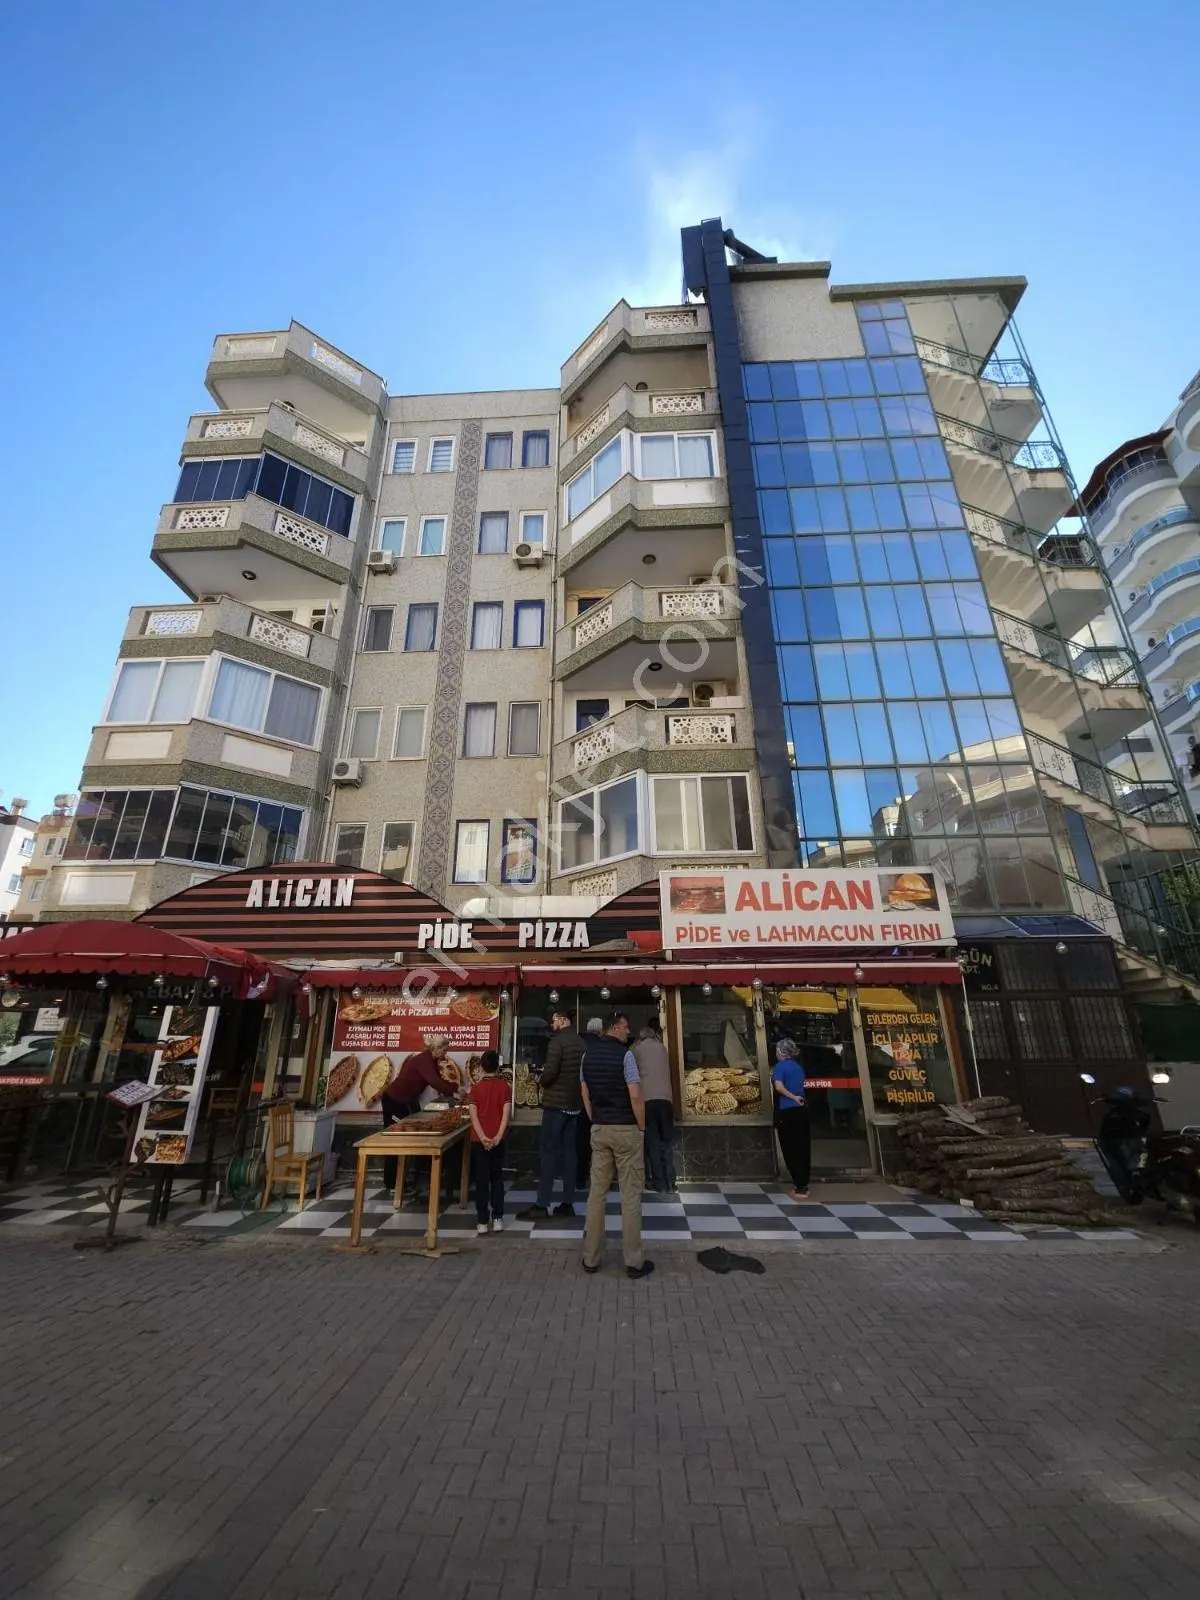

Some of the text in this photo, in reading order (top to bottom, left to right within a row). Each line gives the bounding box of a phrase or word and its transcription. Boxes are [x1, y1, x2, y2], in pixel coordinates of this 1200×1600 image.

[735, 873, 874, 912] ALİCAN
[418, 918, 590, 949] PİDE PİZZA
[676, 921, 942, 943] PİDE ve LAHMACUN FIRINI
[867, 1012, 937, 1025] EVLERDEN GELEN
[897, 1033, 938, 1044] YAPILIR
[816, 1079, 832, 1088] PİDE
[888, 1066, 927, 1084] GÜVEÇ
[887, 1088, 935, 1105] PİŞİRİLİR
